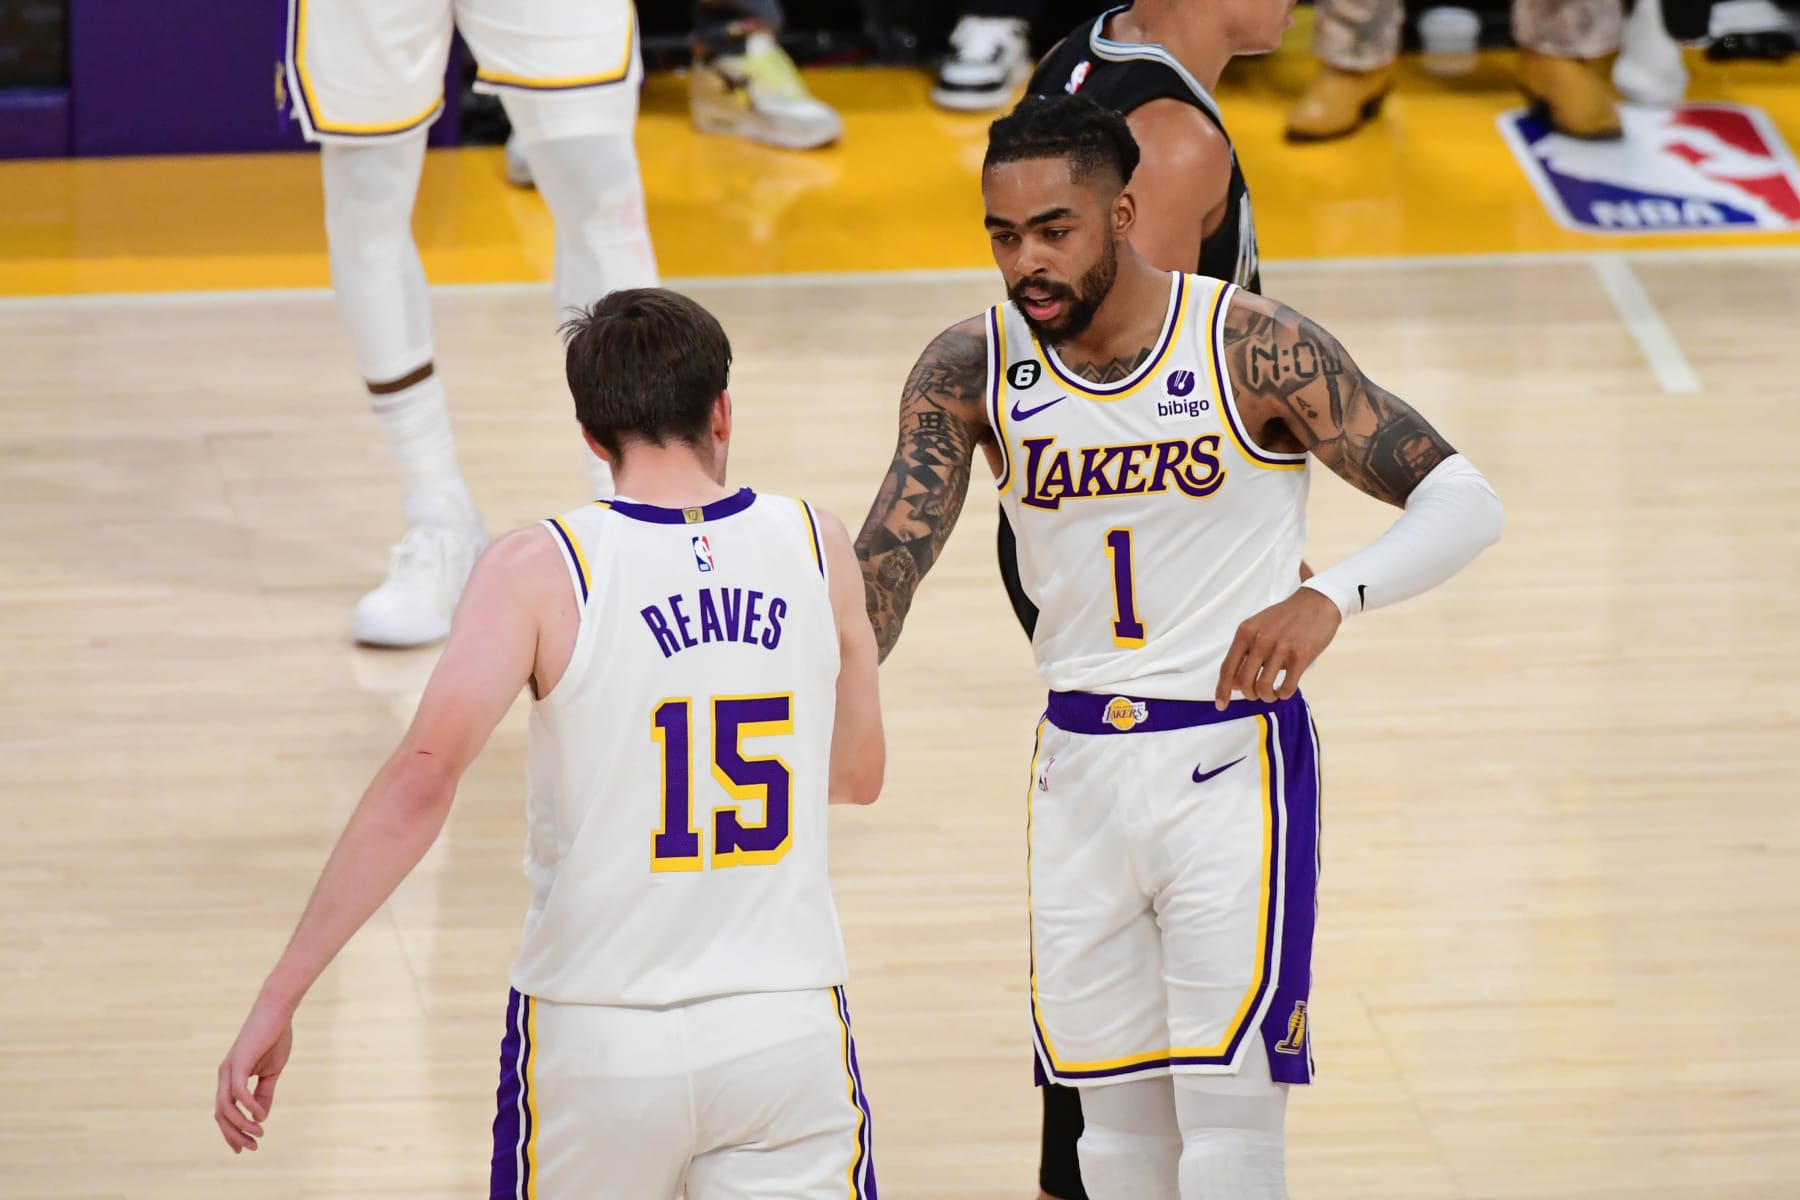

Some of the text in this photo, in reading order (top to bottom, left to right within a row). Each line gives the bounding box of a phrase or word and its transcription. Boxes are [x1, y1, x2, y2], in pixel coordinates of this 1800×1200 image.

[1589, 198, 1729, 227] NBA
[1014, 364, 1035, 387] 6
[1157, 399, 1210, 418] bibigo
[1019, 432, 1229, 512] LAKERS
[640, 587, 787, 658] REAVES
[1103, 525, 1147, 650] 1
[650, 691, 794, 873] 15
